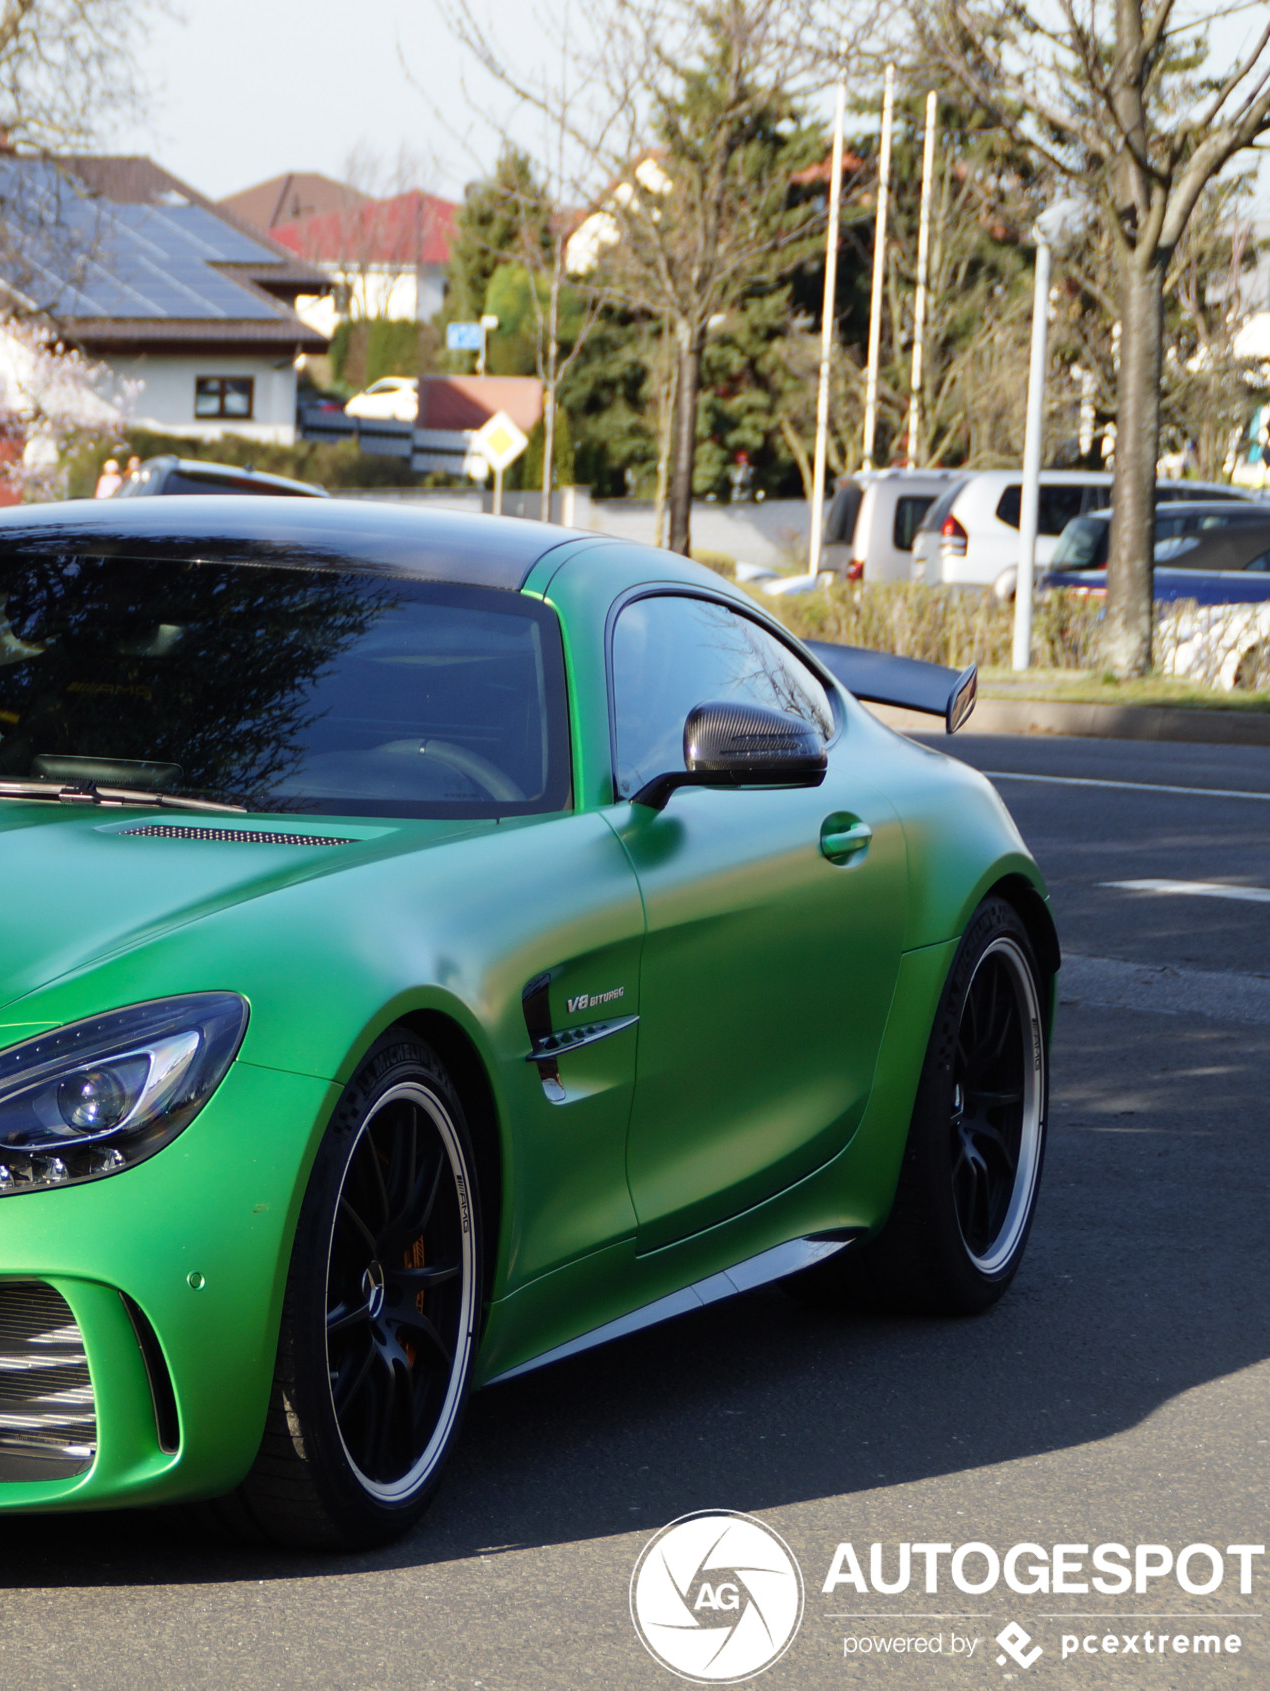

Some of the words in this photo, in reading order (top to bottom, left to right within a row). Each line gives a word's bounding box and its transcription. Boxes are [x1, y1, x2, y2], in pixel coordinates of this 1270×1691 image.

[567, 994, 589, 1013] V8
[589, 986, 625, 1007] BITURBO
[459, 1189, 471, 1234] AMG
